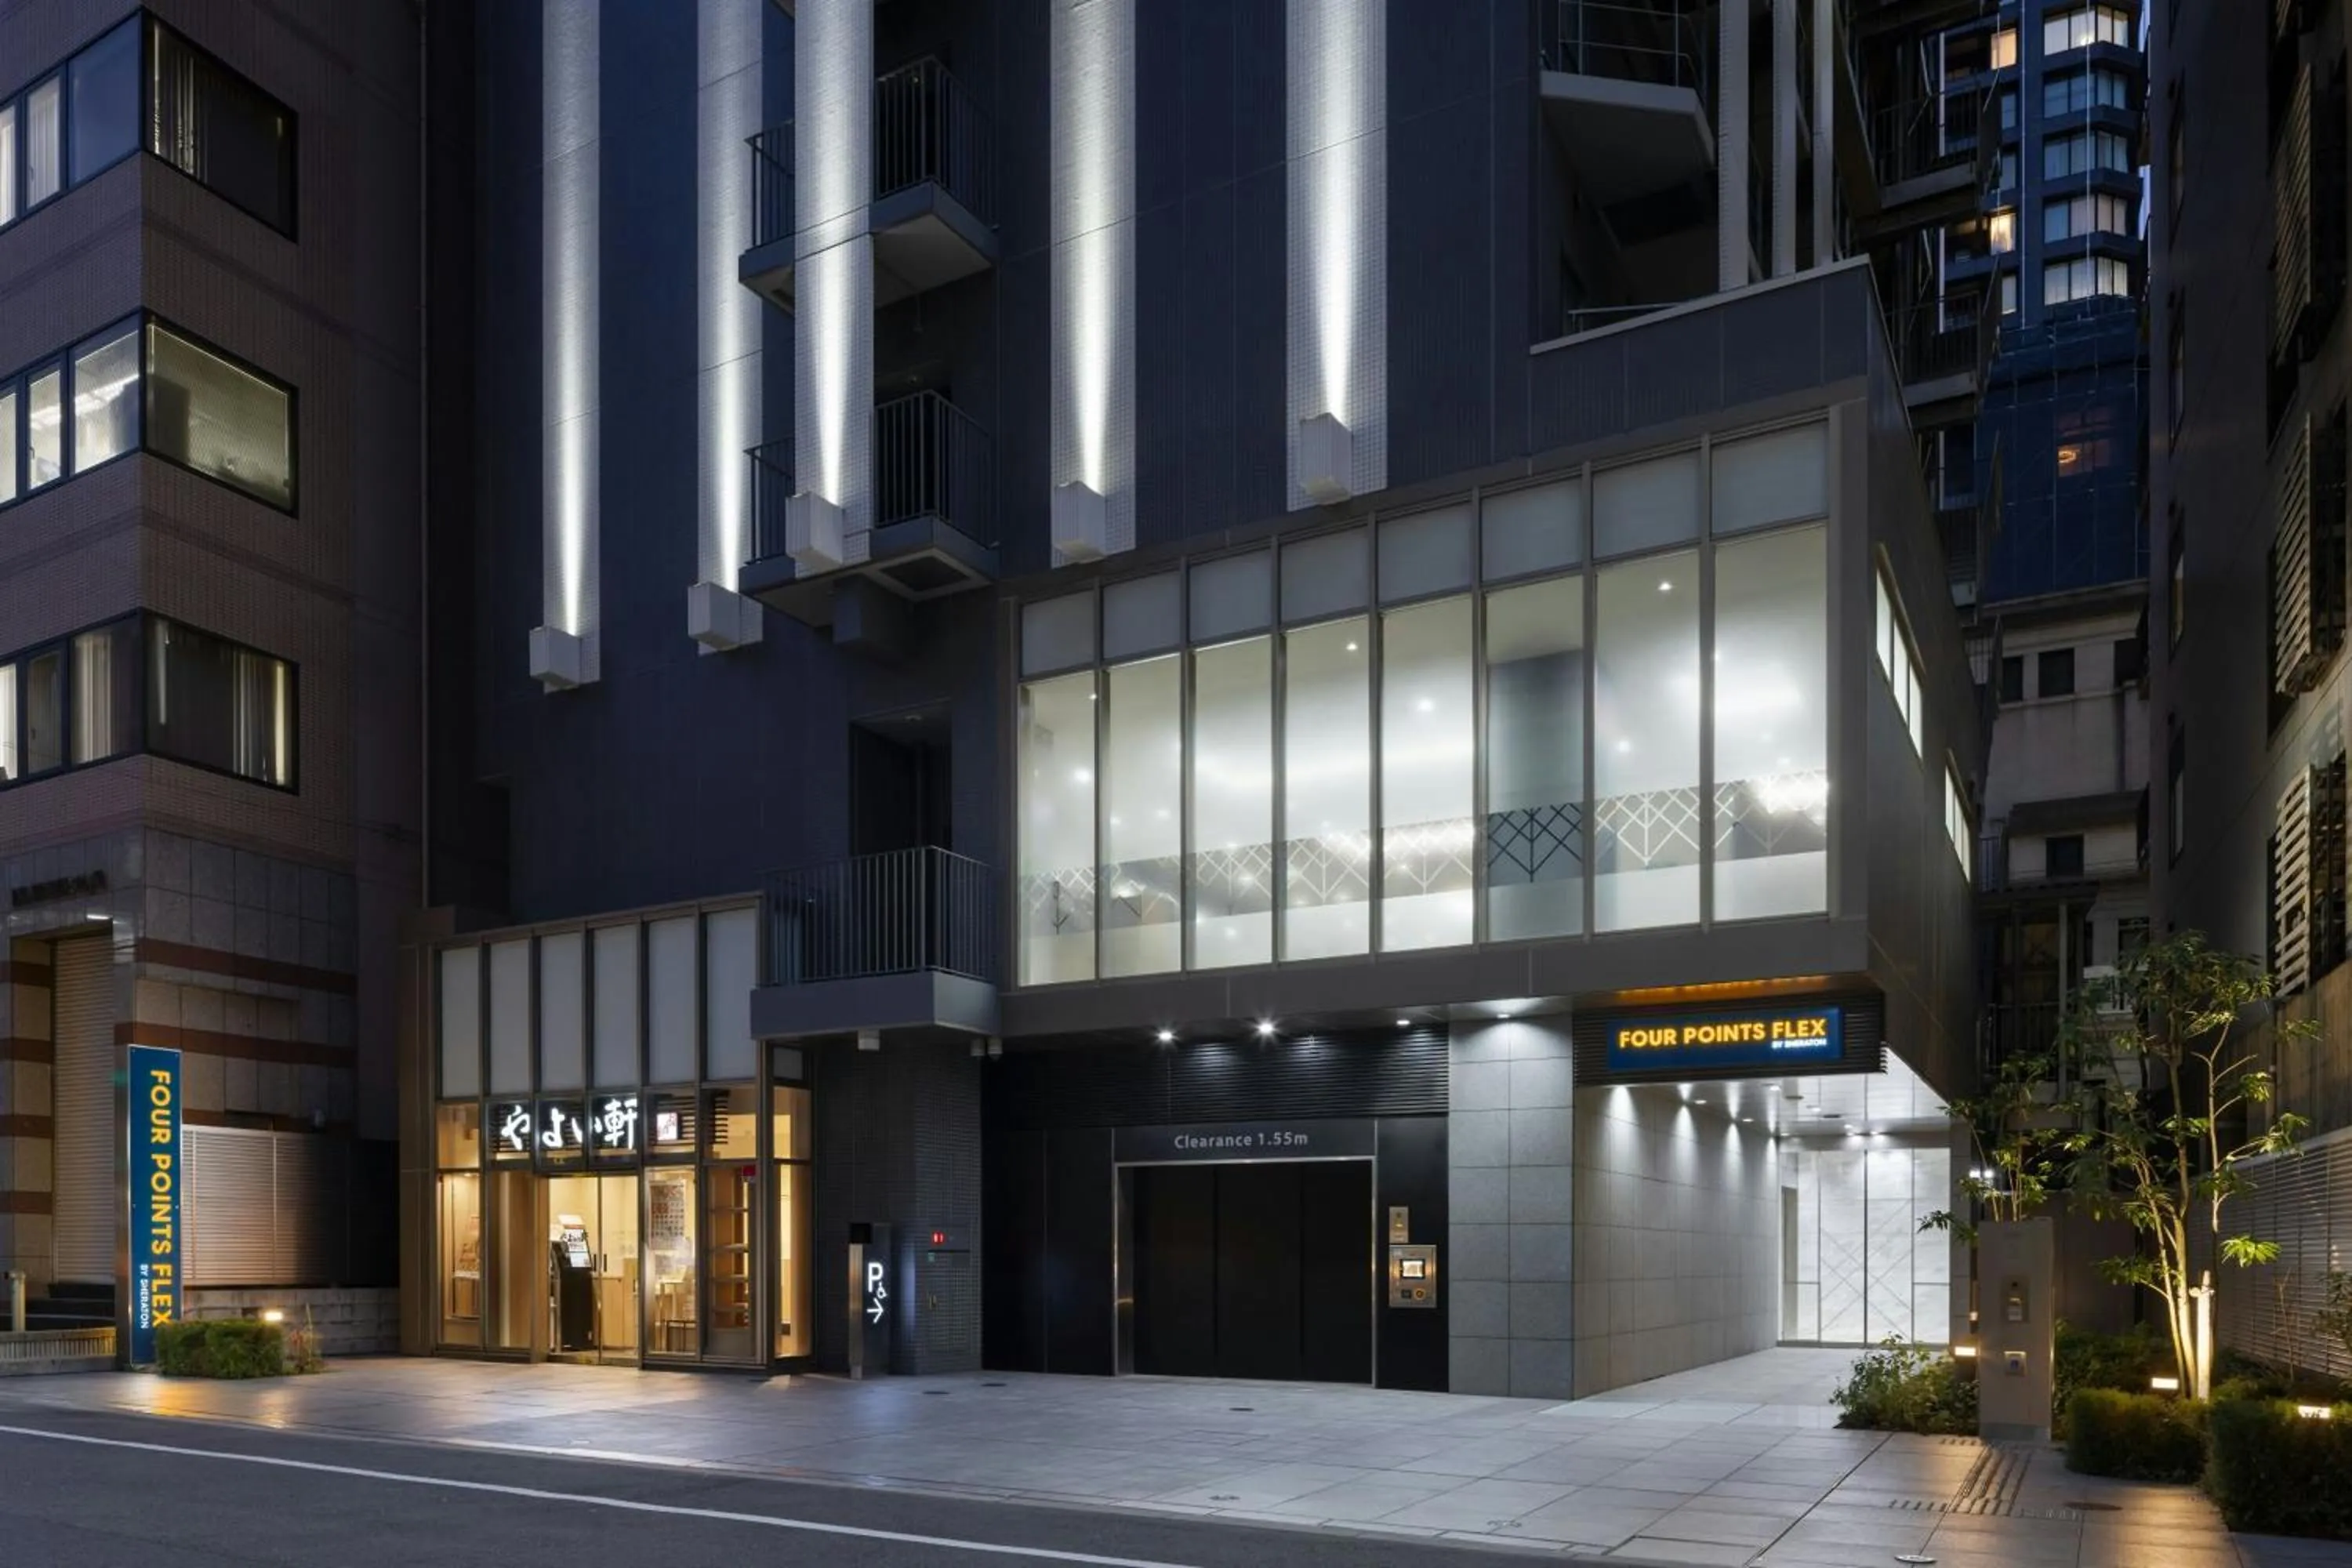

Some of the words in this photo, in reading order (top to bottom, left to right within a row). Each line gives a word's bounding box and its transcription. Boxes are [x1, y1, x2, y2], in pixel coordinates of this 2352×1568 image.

[1619, 1029, 1677, 1048] FOUR
[1683, 1023, 1765, 1044] POINTS
[1772, 1018, 1827, 1039] FLEX
[1771, 1040, 1784, 1049] BY
[1784, 1038, 1828, 1048] SHERATON
[150, 1069, 172, 1144] FOUR
[501, 1098, 637, 1150] やよい軒
[1174, 1134, 1252, 1149] Clearance
[1258, 1131, 1308, 1146] 1.55m
[151, 1153, 172, 1254] POINTS
[140, 1264, 149, 1276] BY
[868, 1262, 884, 1293] P
[140, 1279, 150, 1329] SHERATON
[151, 1264, 172, 1327] FLEX
